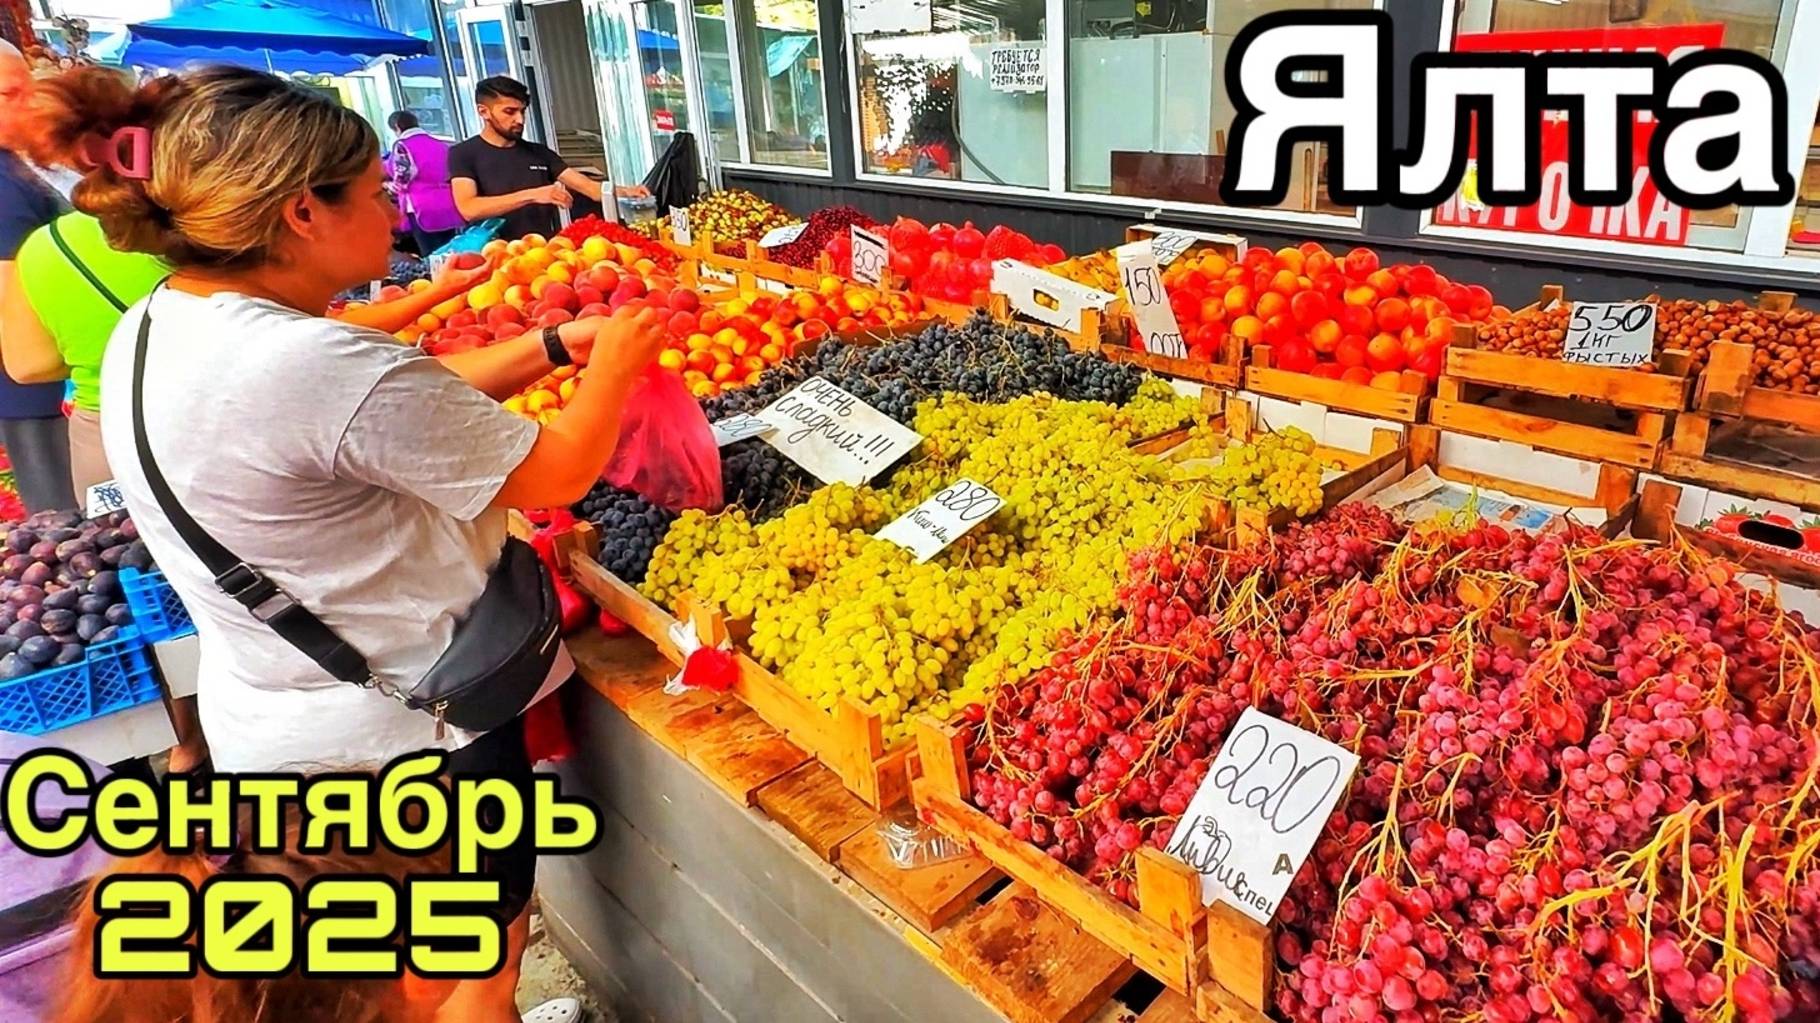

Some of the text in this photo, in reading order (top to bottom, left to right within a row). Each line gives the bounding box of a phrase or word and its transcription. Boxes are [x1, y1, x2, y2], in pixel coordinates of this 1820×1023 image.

[853, 240, 887, 278] 300
[1125, 266, 1161, 306] 150
[1569, 304, 1653, 332] 550
[800, 377, 852, 418] ОЧЕНЬ
[935, 480, 1001, 521] 280
[1214, 724, 1341, 835] 220
